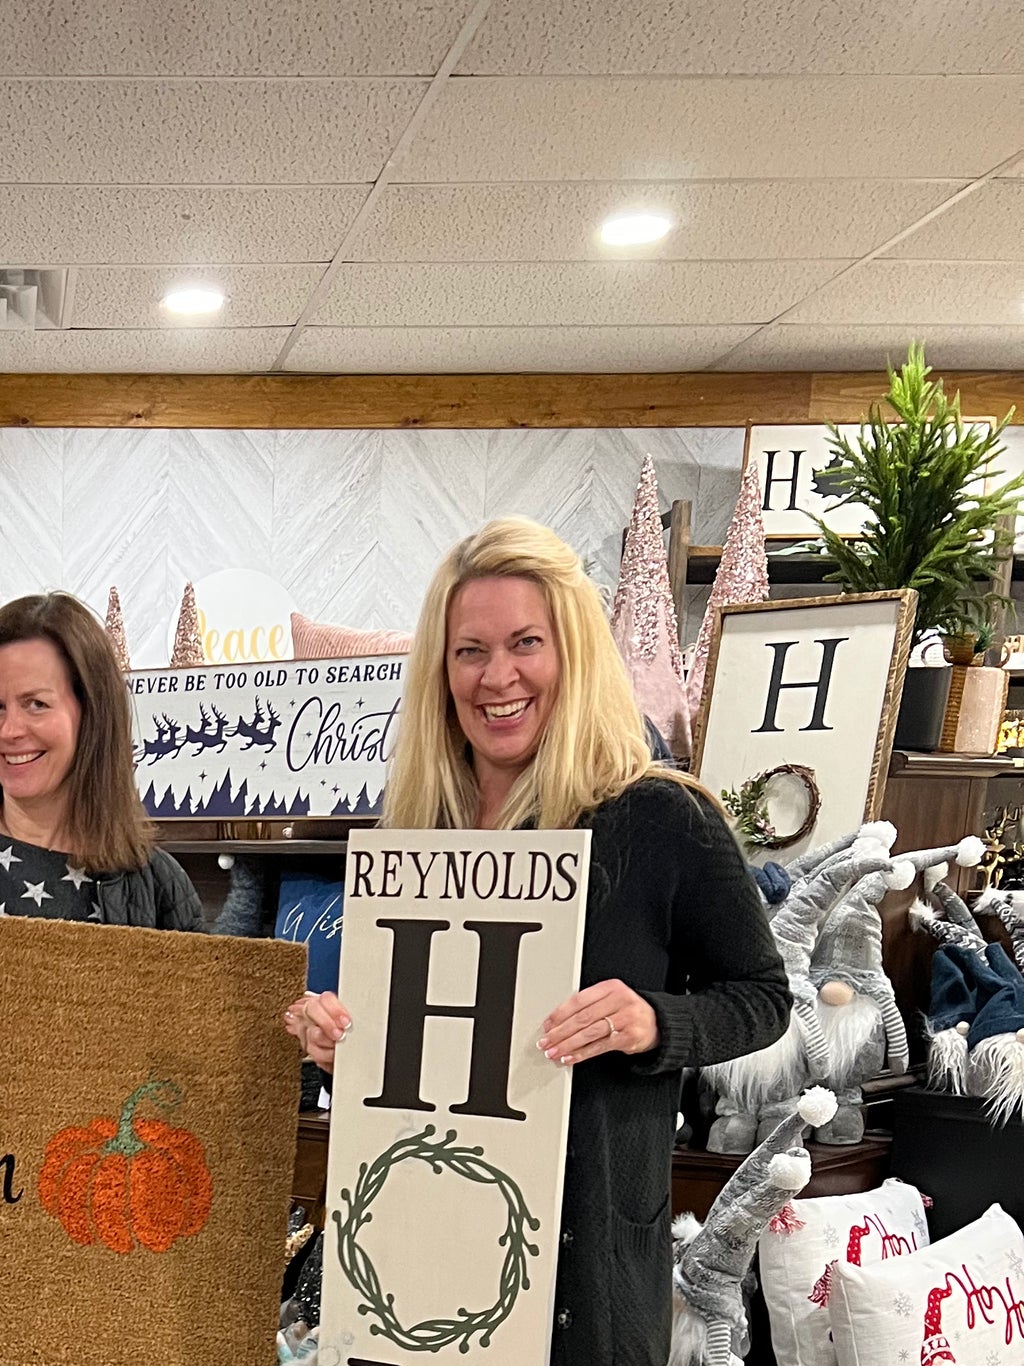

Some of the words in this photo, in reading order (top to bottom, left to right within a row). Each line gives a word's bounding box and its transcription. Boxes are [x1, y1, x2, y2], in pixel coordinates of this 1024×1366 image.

[184, 674, 206, 692] BE
[214, 672, 248, 690] TOO
[254, 669, 288, 688] OLD
[295, 667, 319, 686] TO
[326, 662, 403, 683] SEARCH
[751, 637, 850, 734] H
[349, 850, 580, 902] REYNOLDS
